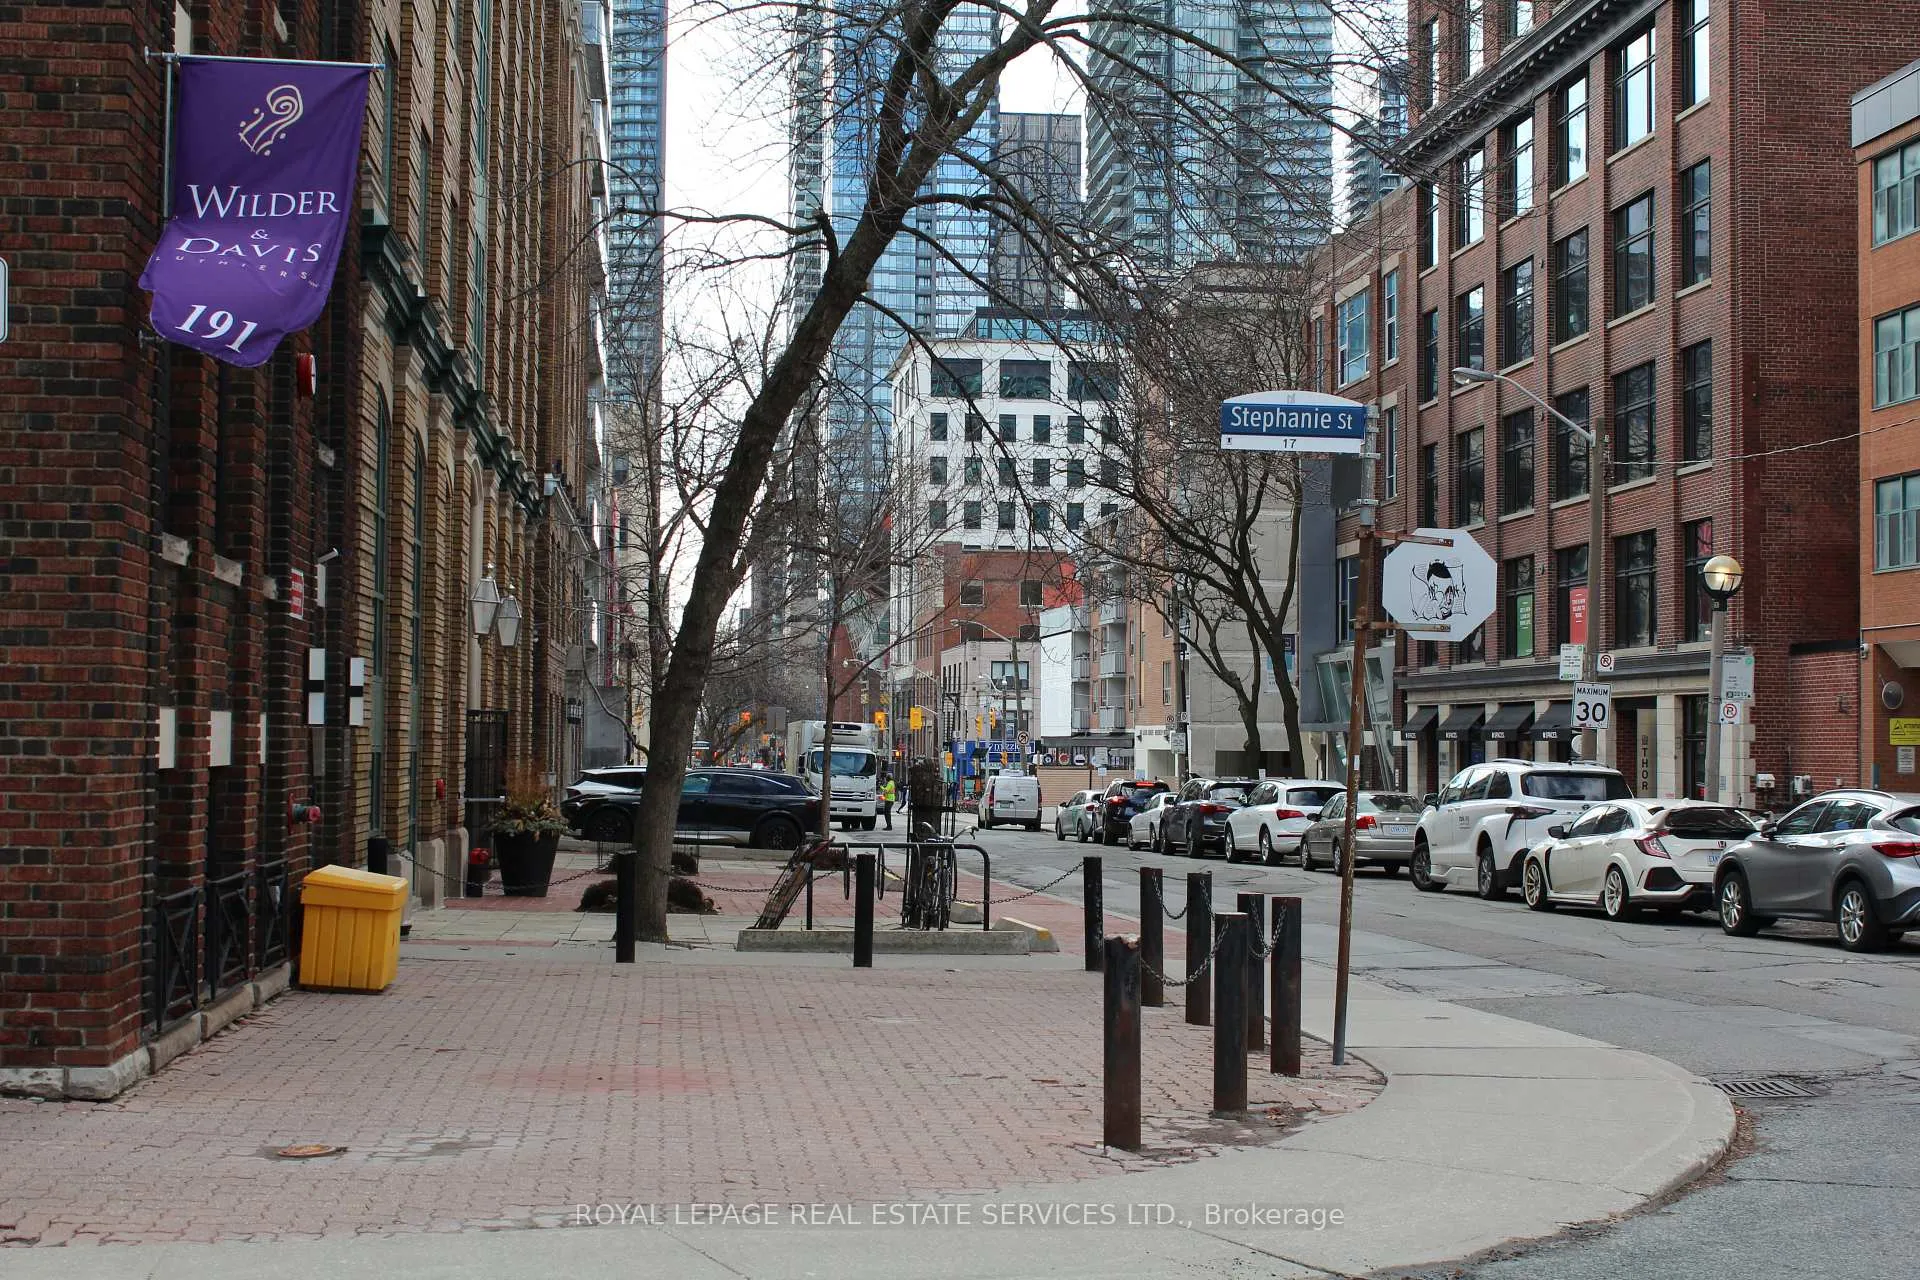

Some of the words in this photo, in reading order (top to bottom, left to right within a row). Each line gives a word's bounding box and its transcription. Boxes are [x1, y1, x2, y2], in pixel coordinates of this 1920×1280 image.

[187, 184, 341, 219] WILDER
[251, 229, 270, 240] &
[176, 237, 321, 264] DAVIS
[175, 304, 258, 353] 191
[1230, 406, 1332, 432] Stephanie
[1337, 412, 1353, 430] St
[1283, 438, 1297, 449] 17
[1576, 687, 1608, 696] MAXIMUM
[1576, 701, 1606, 722] 30
[1641, 747, 1649, 791] THOR
